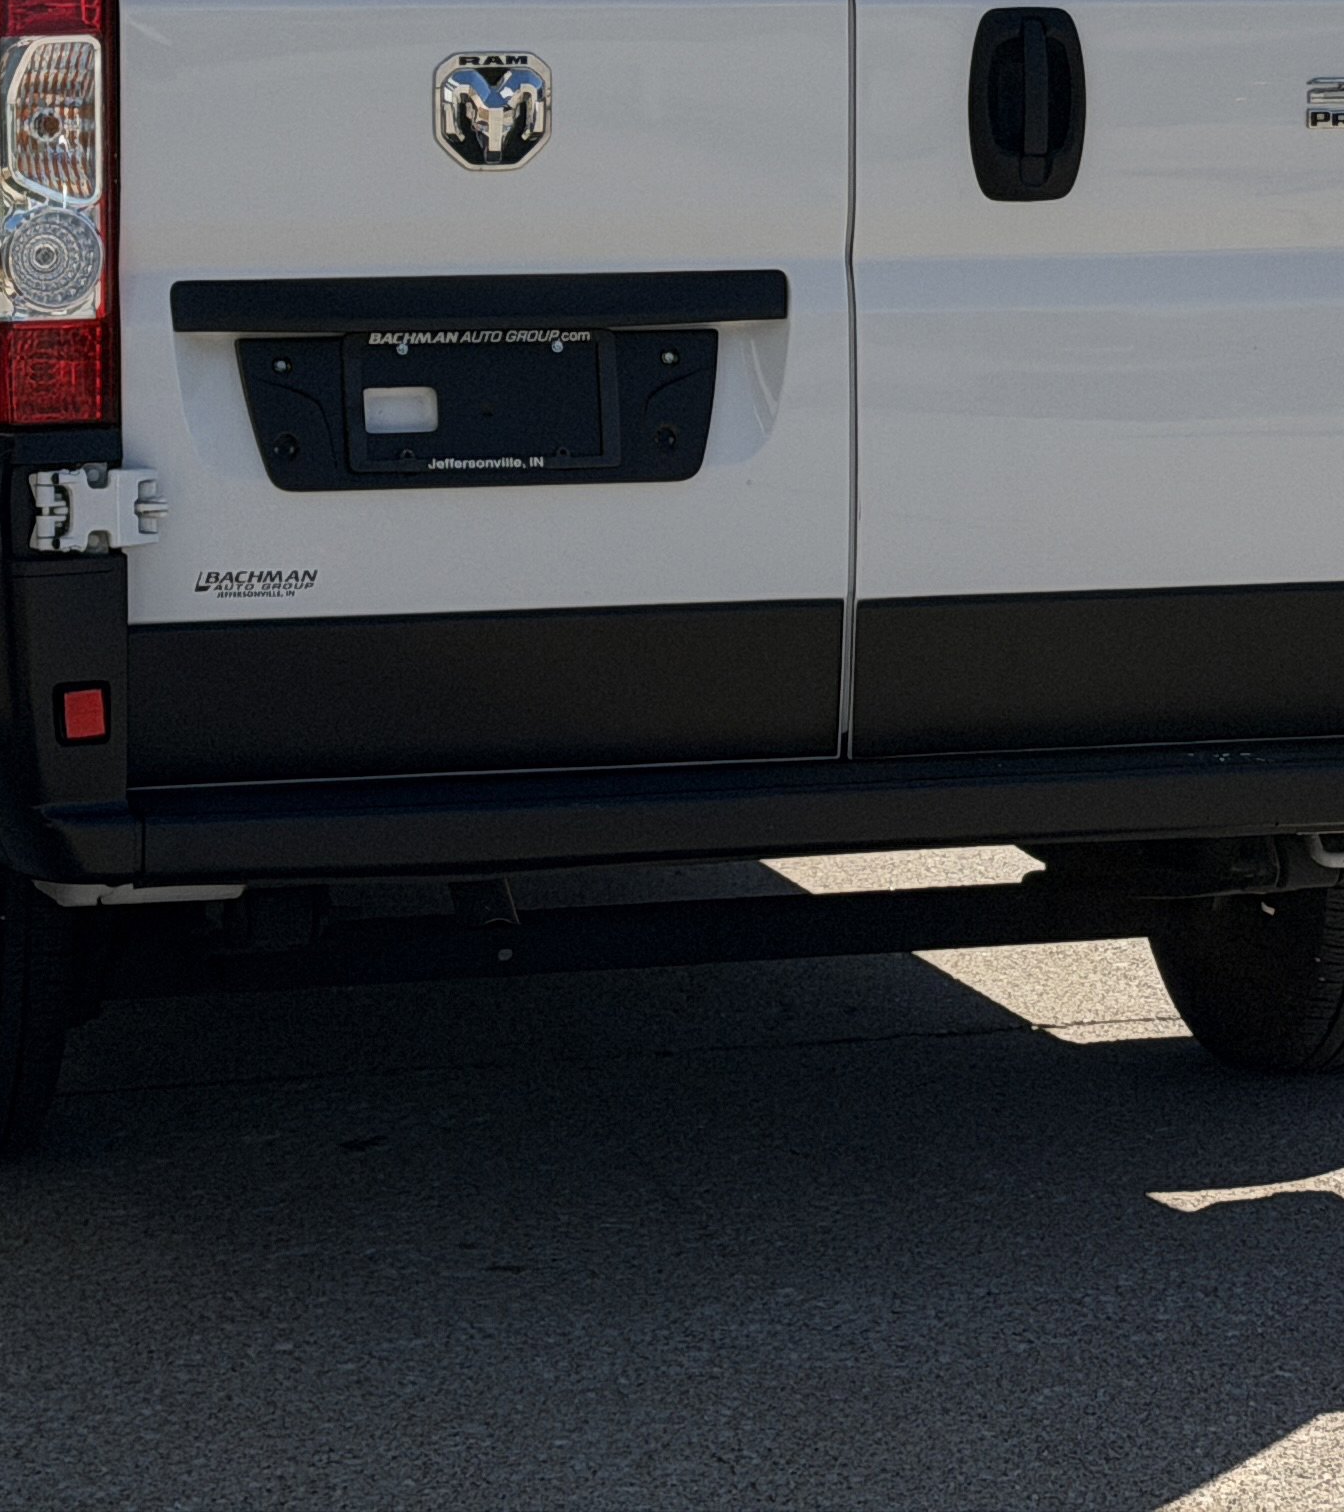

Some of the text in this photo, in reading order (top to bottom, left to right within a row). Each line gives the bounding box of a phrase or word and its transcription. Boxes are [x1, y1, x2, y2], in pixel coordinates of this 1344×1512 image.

[458, 55, 528, 66] RAM
[368, 331, 460, 345] BACHMAN
[459, 330, 503, 344] AUTO
[427, 456, 544, 470] Jeffersonville, IN
[205, 569, 318, 584] BACHMAN
[213, 582, 314, 591] AUTO GROUP
[216, 589, 296, 599] JEFFERSONVILLE, IN
